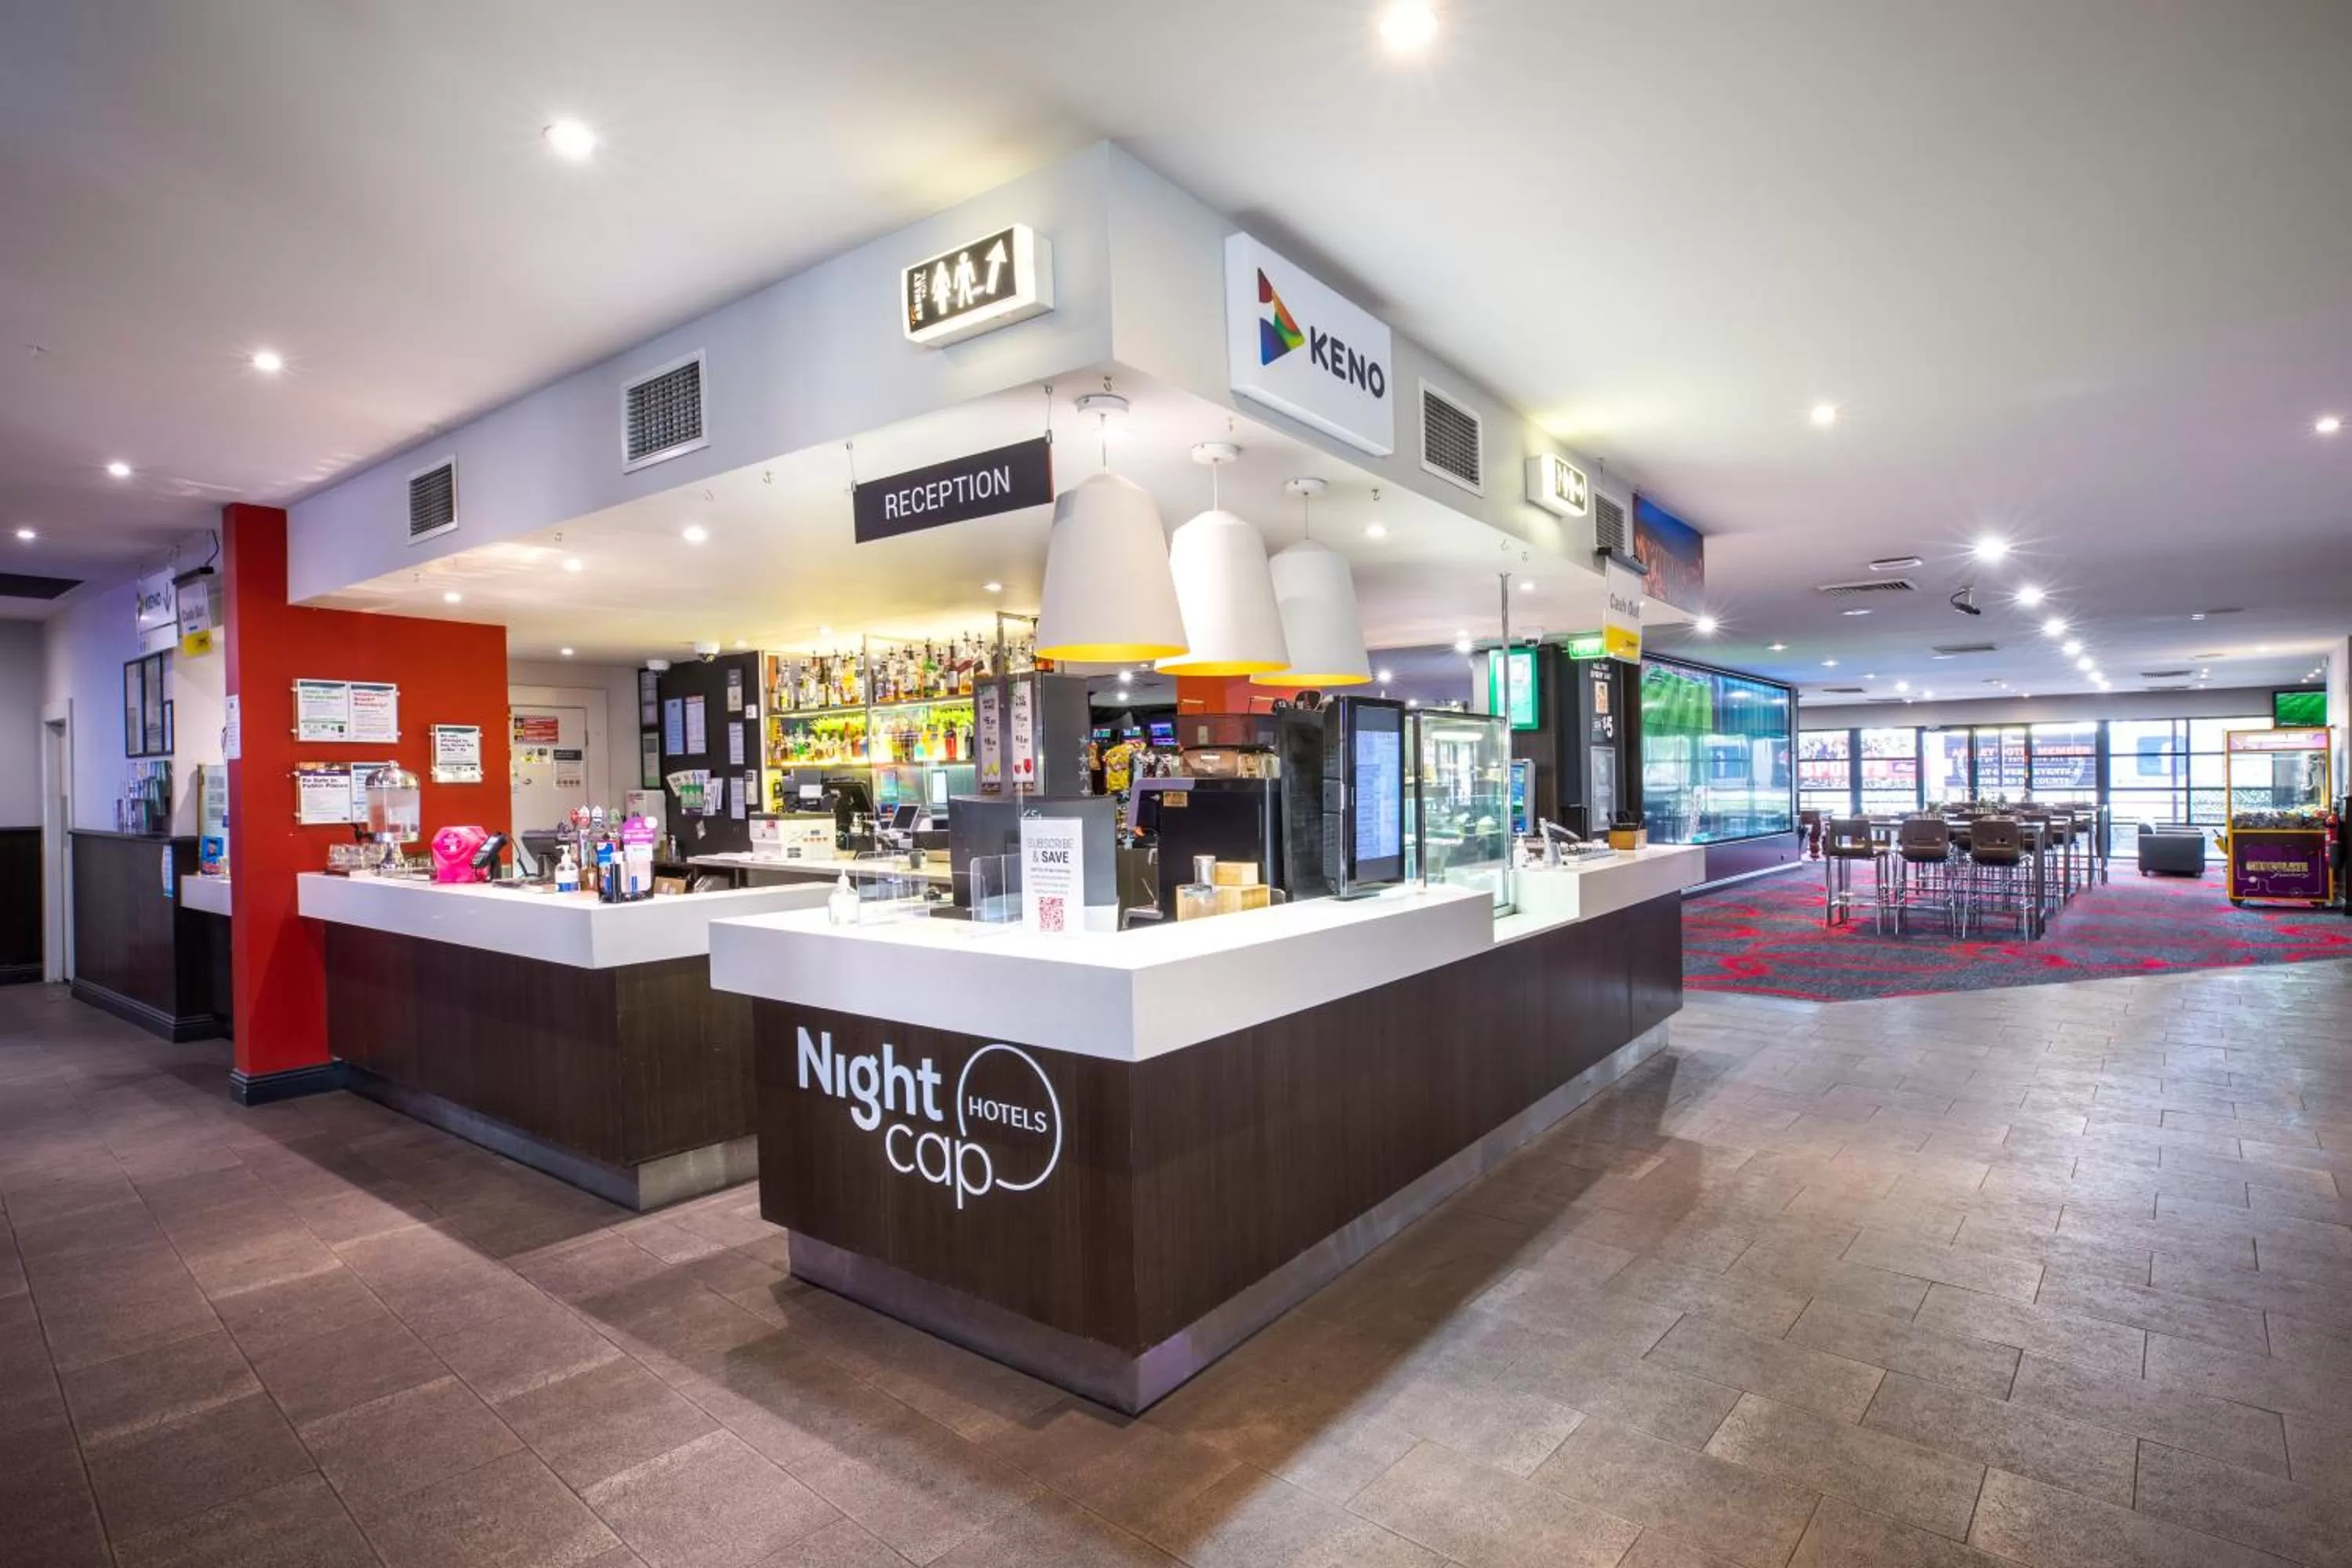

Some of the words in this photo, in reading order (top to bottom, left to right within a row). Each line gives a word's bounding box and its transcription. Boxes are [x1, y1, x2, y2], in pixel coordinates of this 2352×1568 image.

[1310, 325, 1385, 399] KENO
[884, 464, 1011, 520] RECEPTION
[1610, 592, 1627, 615] Cash
[1627, 600, 1640, 619] Out
[1026, 837, 1074, 849] SUBSCRIBE
[1041, 851, 1069, 863] SAVE
[797, 1025, 945, 1131] Night
[968, 1095, 1048, 1134] HOTELS
[885, 1123, 993, 1210] cap
